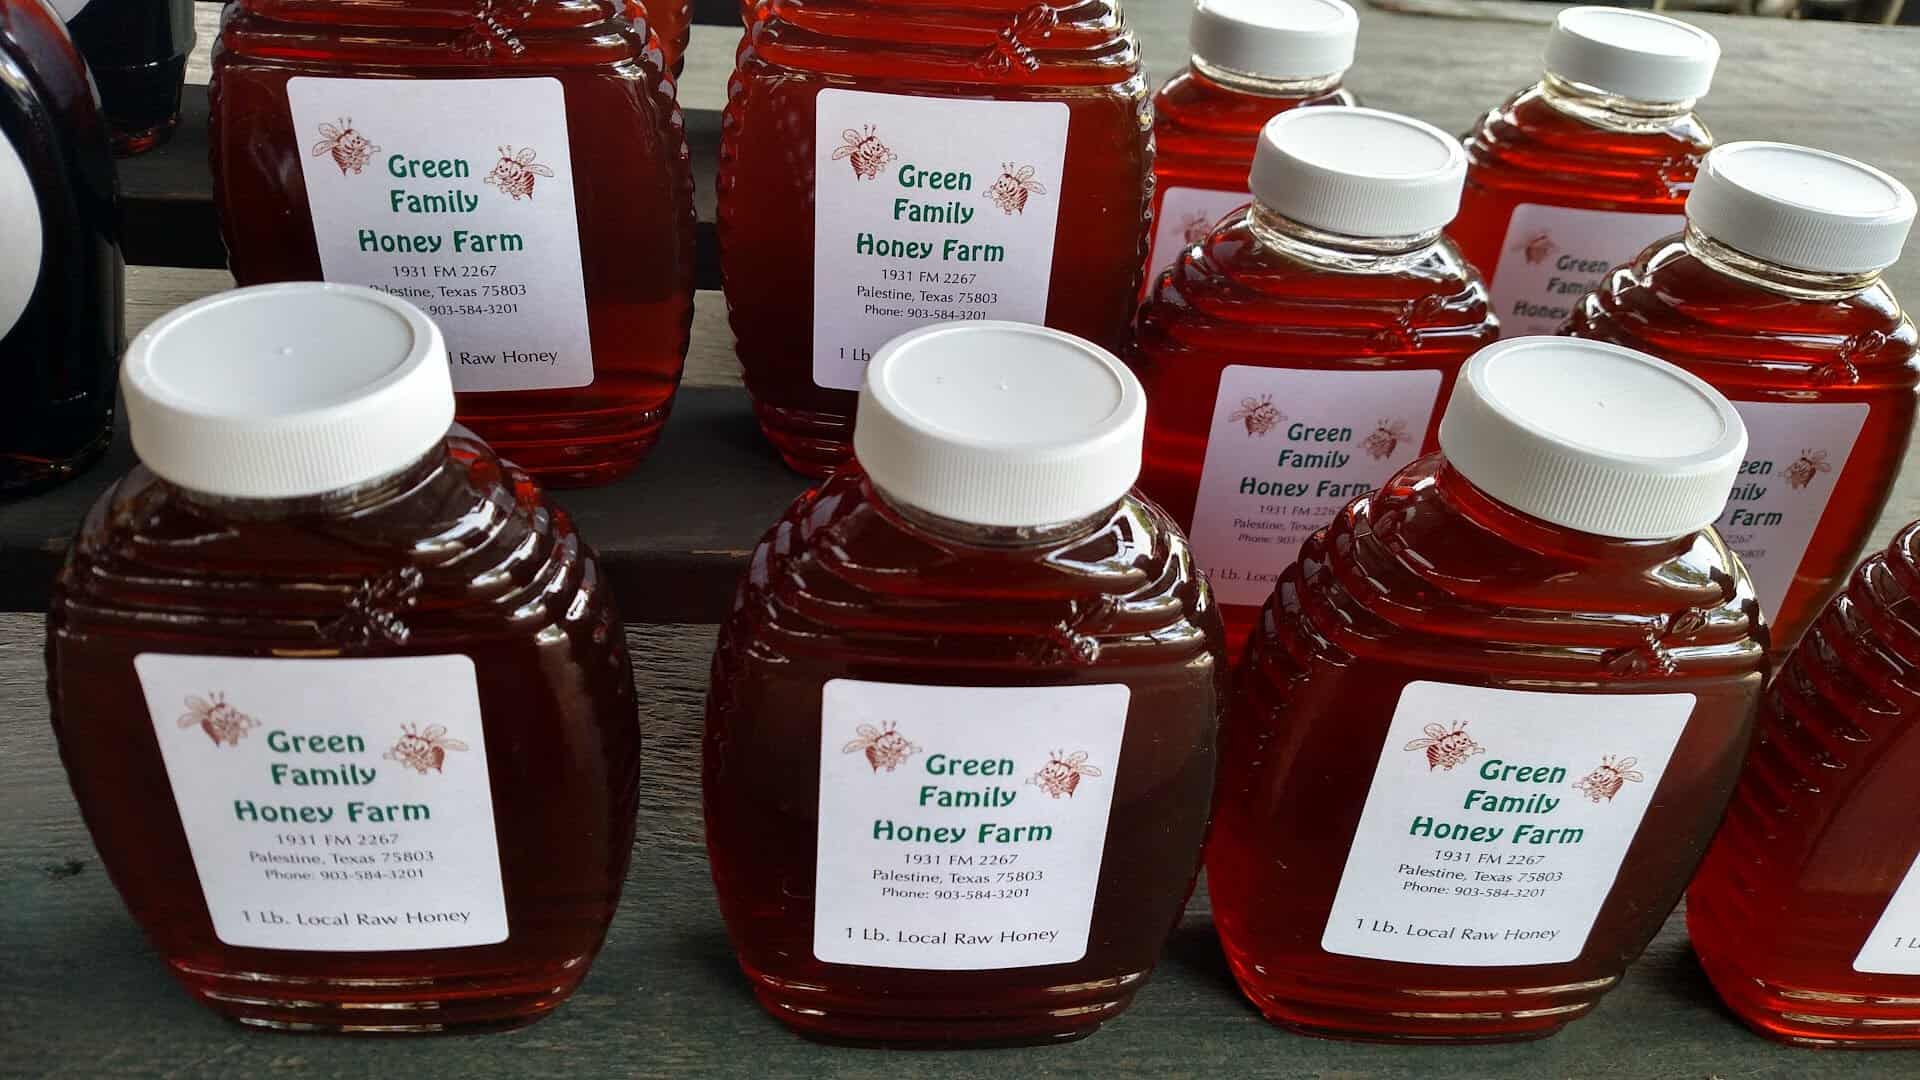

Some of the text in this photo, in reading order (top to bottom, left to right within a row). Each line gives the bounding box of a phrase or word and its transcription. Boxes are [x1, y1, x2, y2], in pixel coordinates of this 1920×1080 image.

[388, 154, 469, 179] Green
[899, 164, 972, 191] Green
[390, 189, 479, 213] Family
[893, 198, 974, 225] Family
[358, 229, 524, 252] Honey Farm
[856, 233, 1005, 262] Honey Farm
[392, 265, 497, 278] 1931 FM 2267
[1556, 255, 1609, 273] Green
[882, 269, 977, 285] 1931 FM 2267
[369, 284, 527, 298] lestine, Texas 75803
[857, 285, 998, 304] Palestine, Texas 75803
[429, 303, 518, 316] 903-584-3201
[865, 304, 987, 321] Phone: 903-584-3201
[460, 352, 496, 365] Raw
[503, 349, 558, 365] Honey
[840, 348, 845, 359] 1
[1287, 423, 1352, 442] Green
[1278, 449, 1350, 469] Family
[1738, 460, 1773, 475] een
[1240, 477, 1308, 497] Honey
[1730, 508, 1783, 526] Farm
[1246, 571, 1279, 581] Loca
[267, 730, 365, 753] Green
[926, 754, 1015, 776] Green
[1479, 759, 1567, 784] Green
[270, 763, 377, 786] Family
[919, 785, 1017, 808] Family
[1464, 789, 1560, 814] Family
[234, 800, 431, 823] Honey Farm
[872, 819, 1053, 843] Honey Farm
[1409, 816, 1584, 844] Honey Farm
[277, 833, 399, 846] 1931 FM 2267
[249, 850, 434, 866] Palestine, Texas 75803
[904, 853, 1019, 866] 1931 FM 2267
[1434, 850, 1545, 866] 1931 FM 2267
[264, 868, 424, 881] Phone: 903-584-3201
[872, 869, 1043, 885] Palestine, Texas 75803
[1398, 864, 1563, 882] Palestine, Texas 75803
[881, 887, 1030, 900] Phone: 903-584-3201
[1402, 881, 1545, 898] Phone: 903-584-3201
[242, 910, 471, 926] 1 Lb. Local Raw Honey
[846, 927, 1059, 945] 1 Lb. Local Raw Honey
[1356, 919, 1560, 943] 1 Lb. Local Raw Honey
